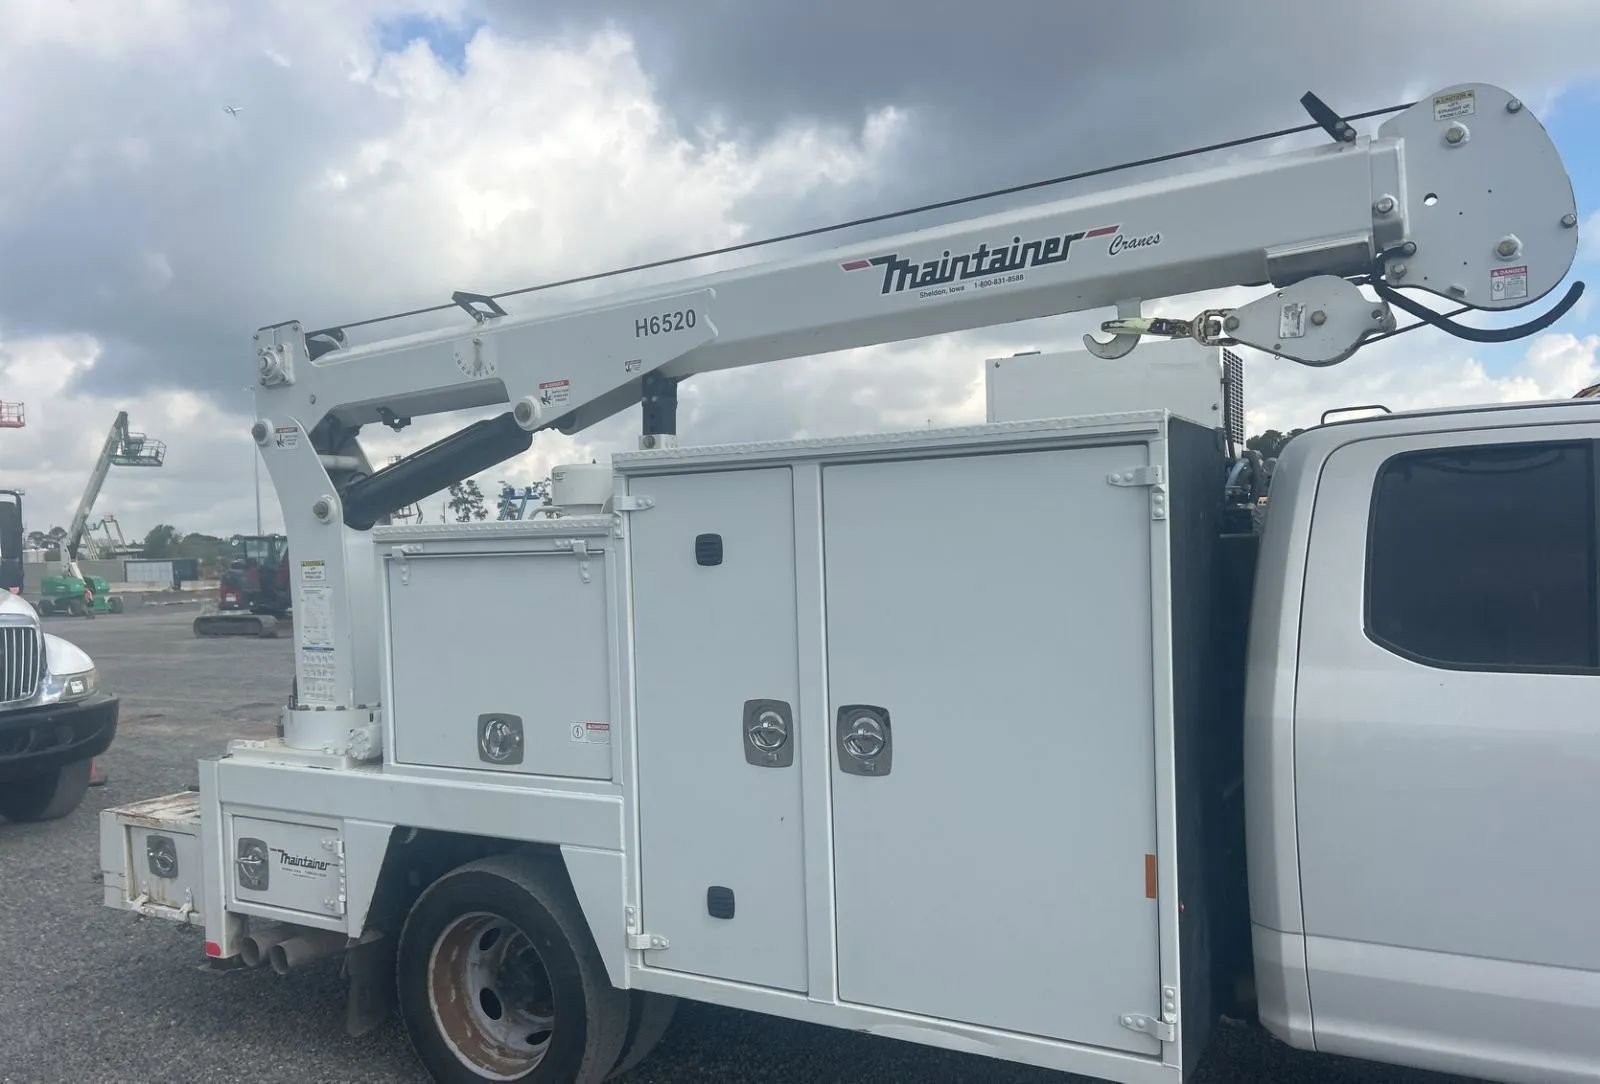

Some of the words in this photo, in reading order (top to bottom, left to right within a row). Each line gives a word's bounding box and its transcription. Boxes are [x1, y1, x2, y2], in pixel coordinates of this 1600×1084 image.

[868, 231, 1086, 294] Maintainer
[1109, 234, 1160, 256] Cranes
[919, 287, 948, 299] Sheldon,
[948, 285, 965, 294] Iowa
[635, 309, 696, 338] H6520
[278, 849, 331, 871] Maintainer
